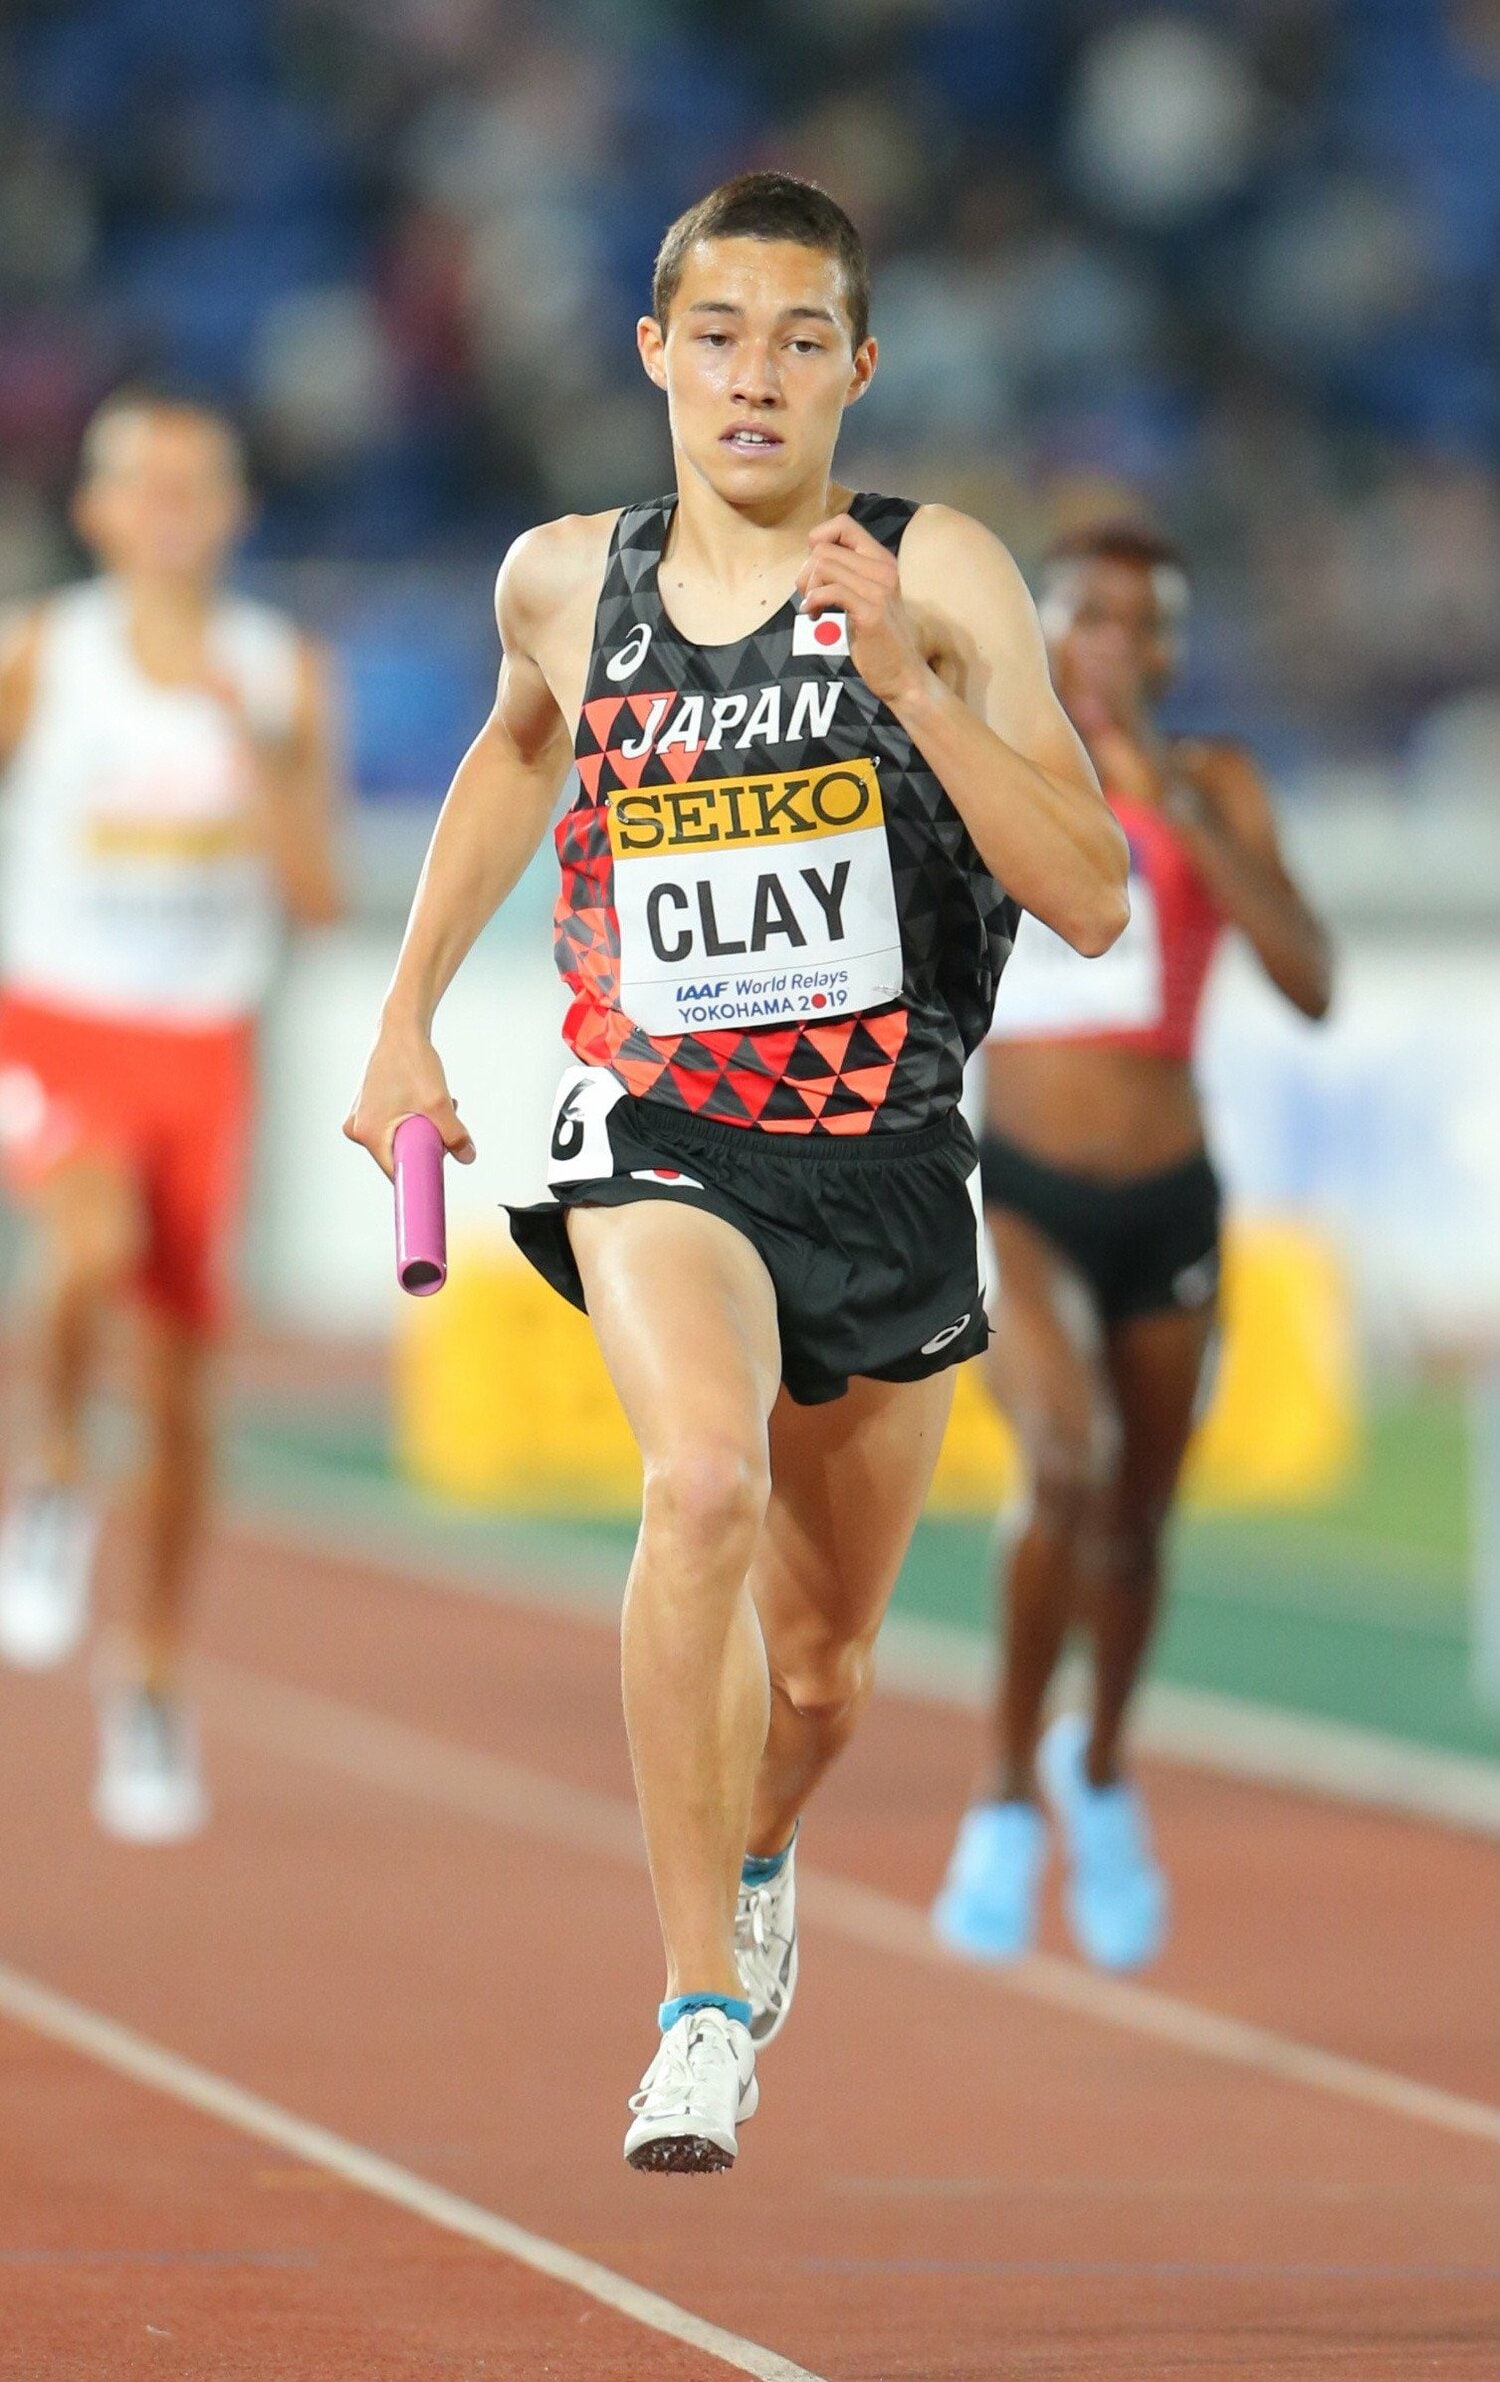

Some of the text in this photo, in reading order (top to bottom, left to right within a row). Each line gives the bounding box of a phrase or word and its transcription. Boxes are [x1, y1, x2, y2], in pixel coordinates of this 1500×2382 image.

[621, 680, 844, 759] JAPAN
[618, 771, 870, 850] SEIKO
[646, 861, 852, 962] CLAY
[676, 970, 848, 1001] IAAF World Relays
[678, 999, 795, 1024] YOKOHAMA
[551, 1078, 594, 1160] 6
